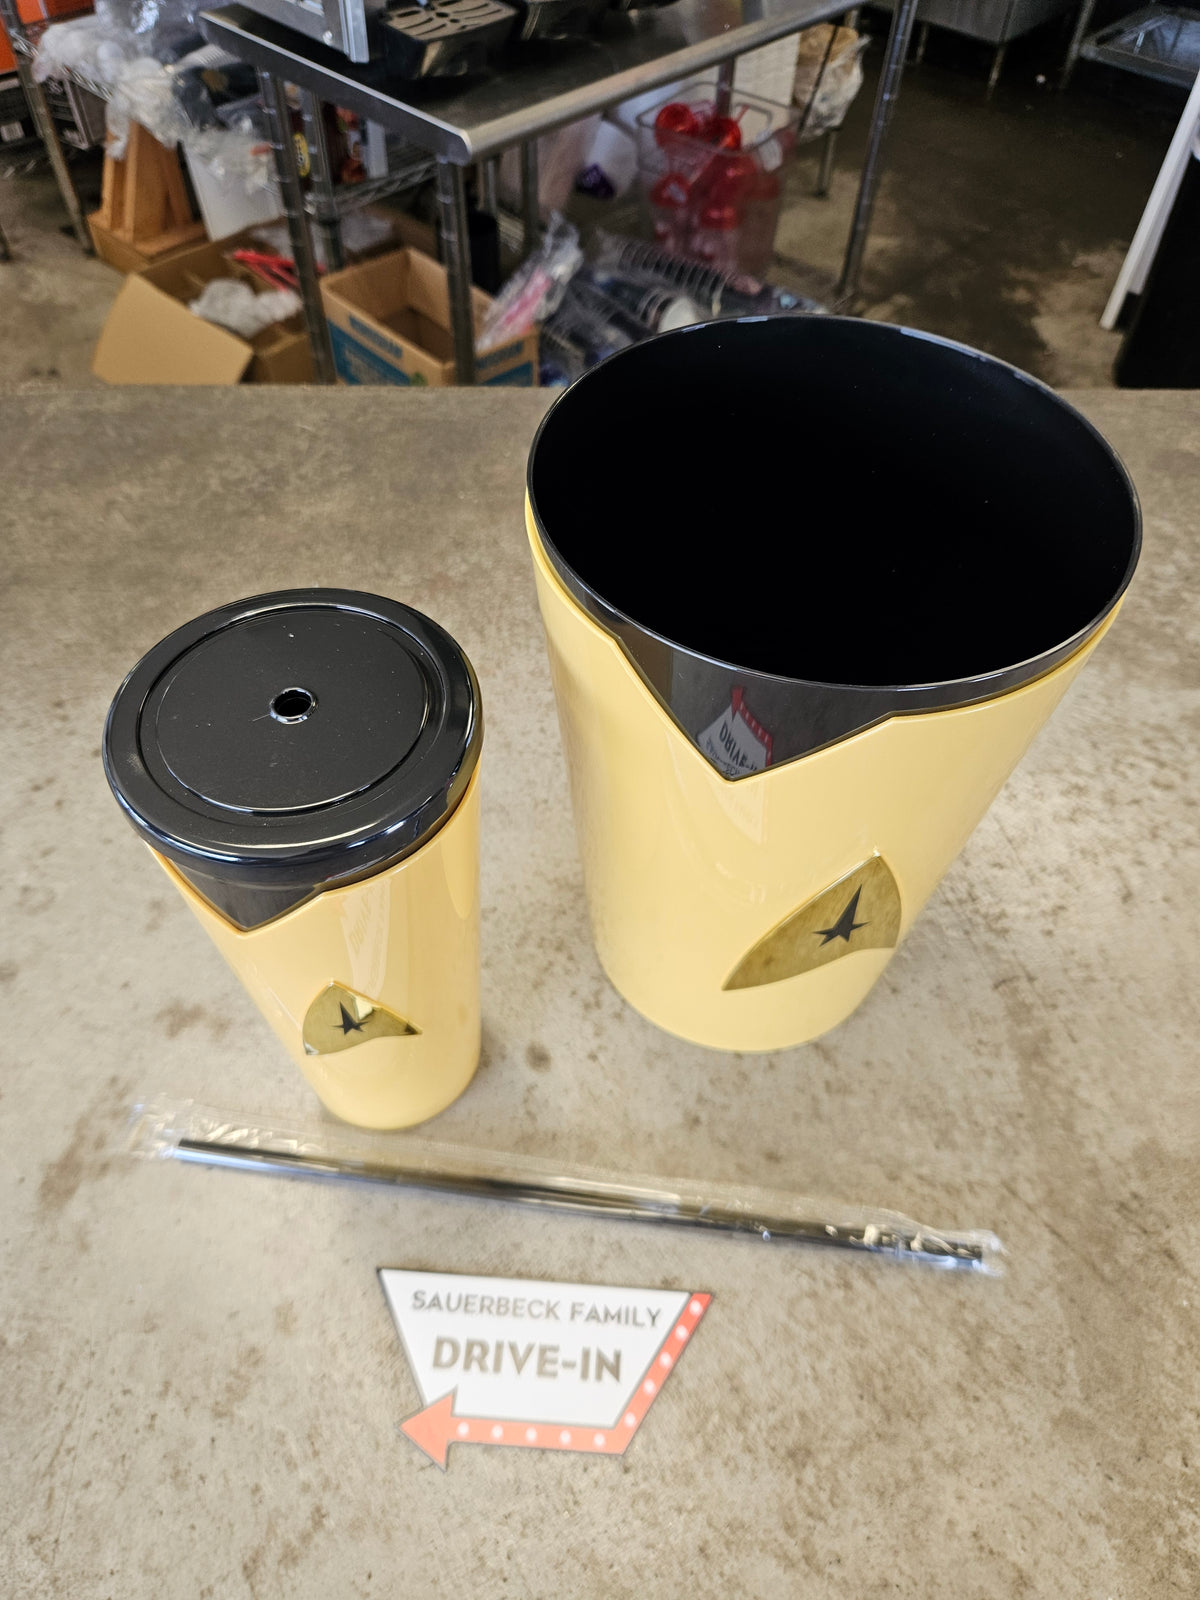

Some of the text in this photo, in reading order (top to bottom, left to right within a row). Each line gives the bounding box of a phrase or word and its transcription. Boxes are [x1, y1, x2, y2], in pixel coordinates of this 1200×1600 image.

[412, 1290, 662, 1328] SAUERBECK FAMILY
[432, 1336, 621, 1383] DRIVE-IN
